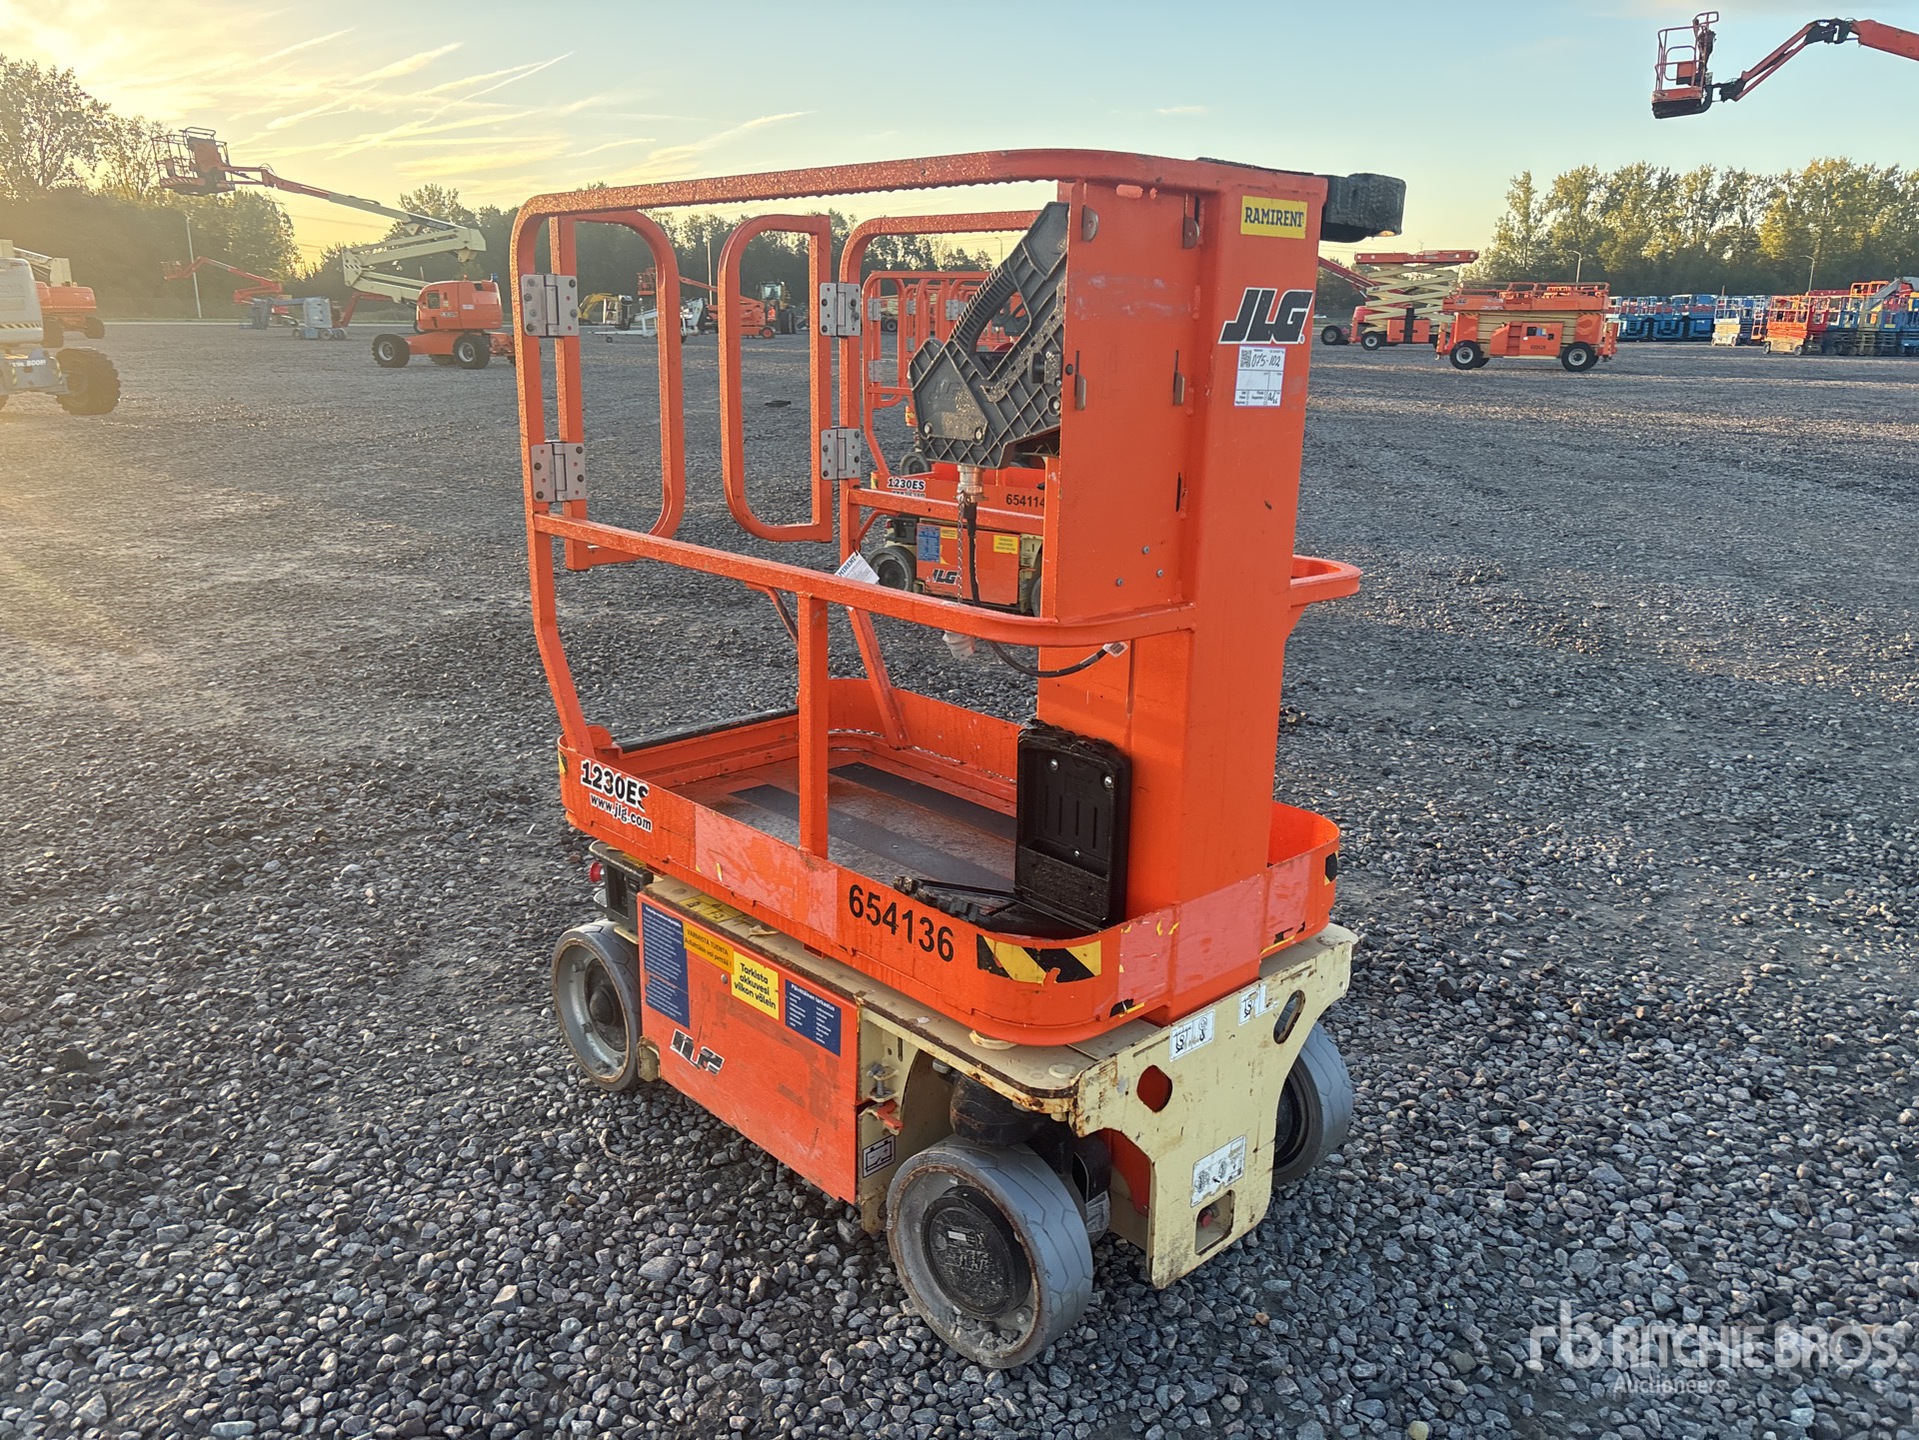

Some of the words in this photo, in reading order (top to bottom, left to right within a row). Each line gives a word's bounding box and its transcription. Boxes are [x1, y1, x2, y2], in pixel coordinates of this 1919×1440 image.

[1244, 206, 1304, 228] RAMIRENT
[1218, 287, 1314, 344] JLG
[887, 477, 926, 490] 1230ES
[581, 759, 650, 812] 1230ES
[589, 793, 652, 832] www.jlg.com
[849, 884, 954, 963] 654136
[739, 974, 770, 996] akkuvesi
[740, 962, 769, 985] Tarkista
[754, 990, 776, 1010] välein
